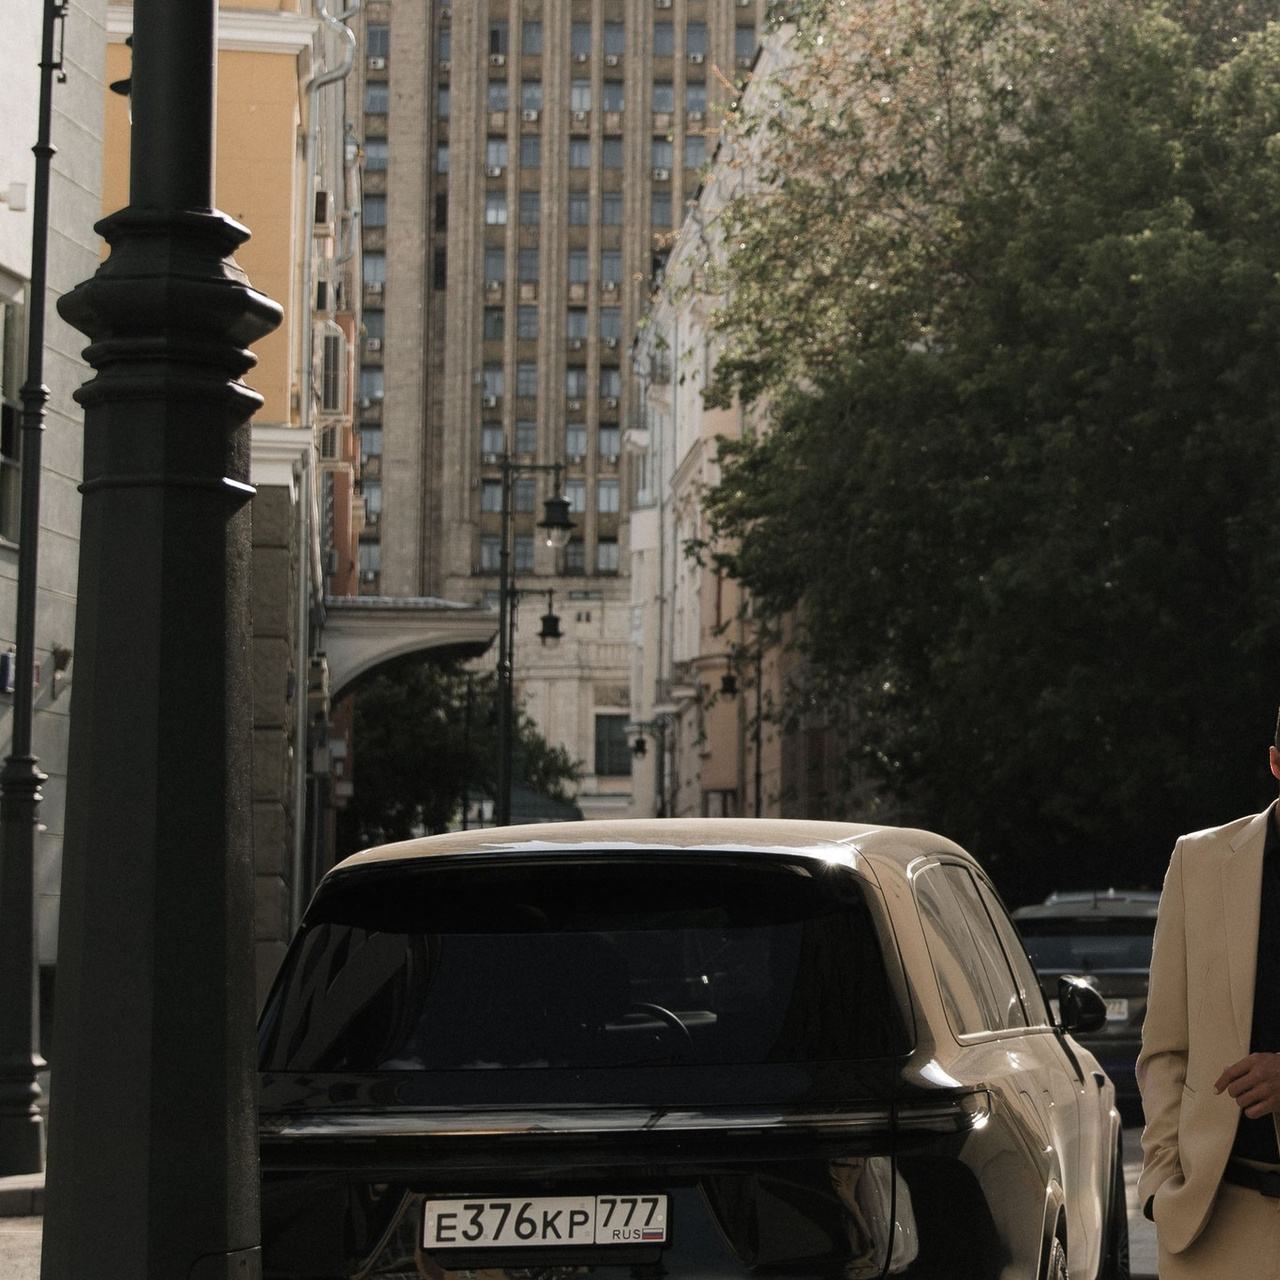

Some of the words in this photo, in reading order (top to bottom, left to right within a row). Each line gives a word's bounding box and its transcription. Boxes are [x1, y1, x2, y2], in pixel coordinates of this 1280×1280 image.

[435, 1202, 590, 1243] E376KP
[599, 1197, 660, 1227] 777
[612, 1229, 641, 1240] RUS
